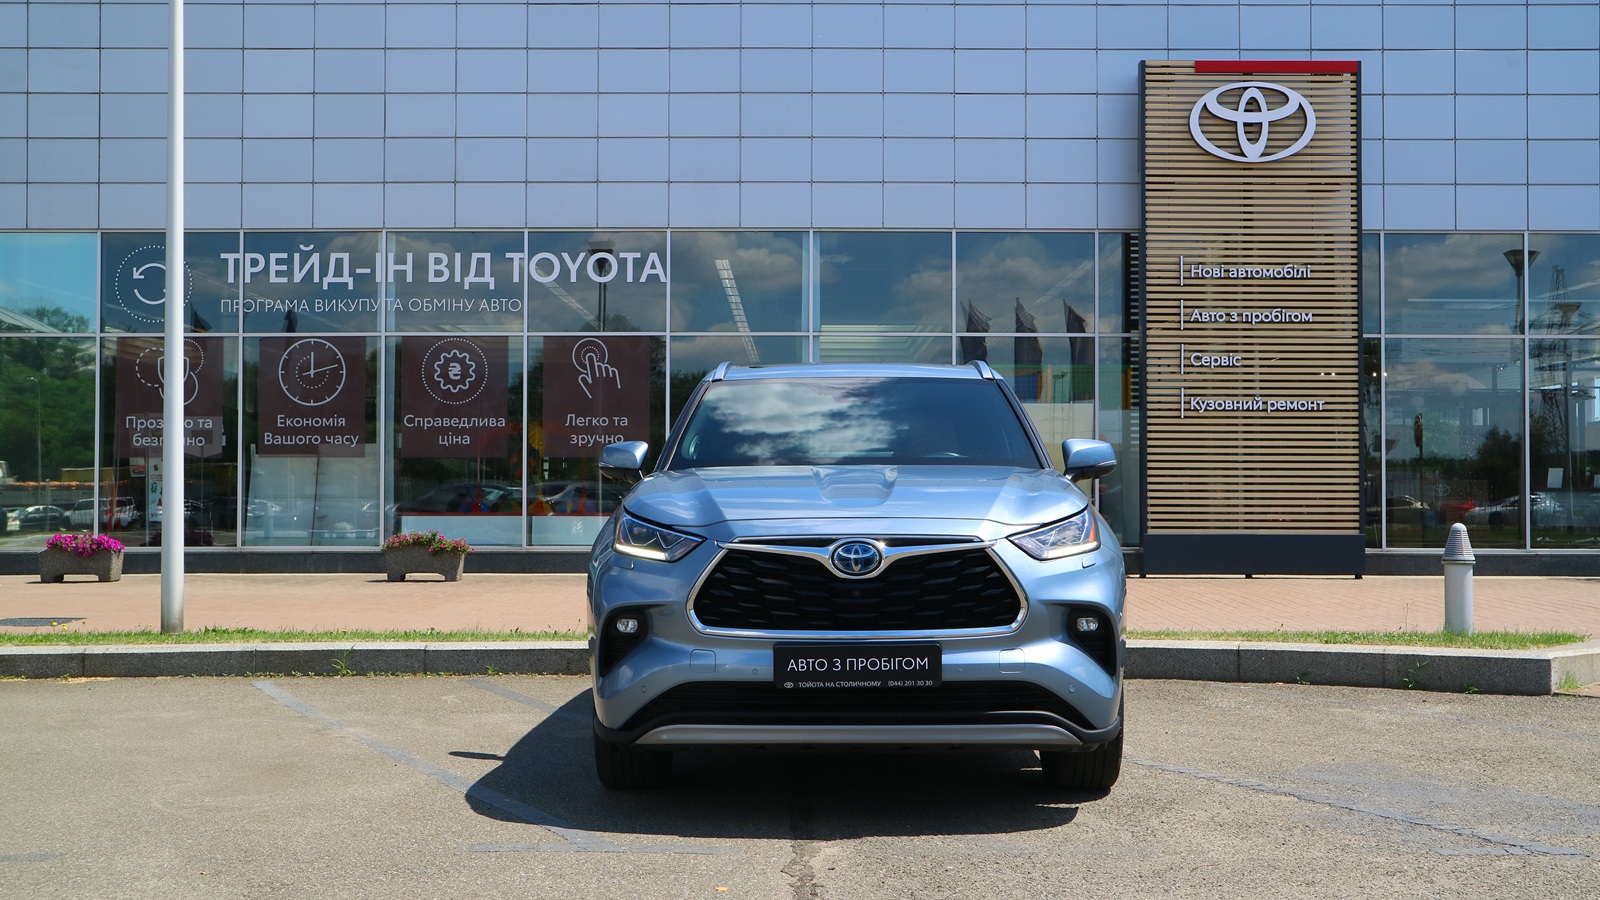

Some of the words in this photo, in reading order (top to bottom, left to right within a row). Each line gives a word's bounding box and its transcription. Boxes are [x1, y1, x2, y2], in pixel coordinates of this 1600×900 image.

[220, 244, 413, 290] ТРЕЙД-ІН
[428, 252, 495, 290] ВІД
[505, 252, 667, 283] TOYOTA
[1191, 264, 1225, 279] Нові
[1229, 264, 1311, 279] автомобілі
[220, 299, 310, 313] ПРОГРАМА
[315, 298, 381, 312] ВИКУПУ
[384, 298, 404, 312] ТА
[408, 298, 474, 312] ОБМІНУ
[478, 298, 522, 312] АВТО
[1190, 309, 1226, 322] Авто
[1229, 312, 1239, 323] з
[1242, 308, 1313, 325] пробігом
[1190, 353, 1242, 369] Сервіс
[1190, 396, 1264, 414] Кузовний
[1267, 400, 1326, 415] ремонт
[125, 416, 194, 431] Прозо
[197, 419, 213, 429] та
[276, 414, 346, 427] Економія
[403, 414, 506, 430] Справедлива
[565, 414, 609, 427] Легко
[612, 416, 629, 427] та
[132, 433, 206, 447] безно
[263, 432, 321, 446] Вашого
[325, 434, 360, 448] часу
[438, 432, 471, 446] ціна
[569, 434, 624, 446] зручно
[787, 658, 828, 672] АВТО
[832, 659, 842, 671] З
[846, 657, 929, 671] ПРОБІГОМ
[835, 680, 882, 688] СТОЛИЧНОМУ
